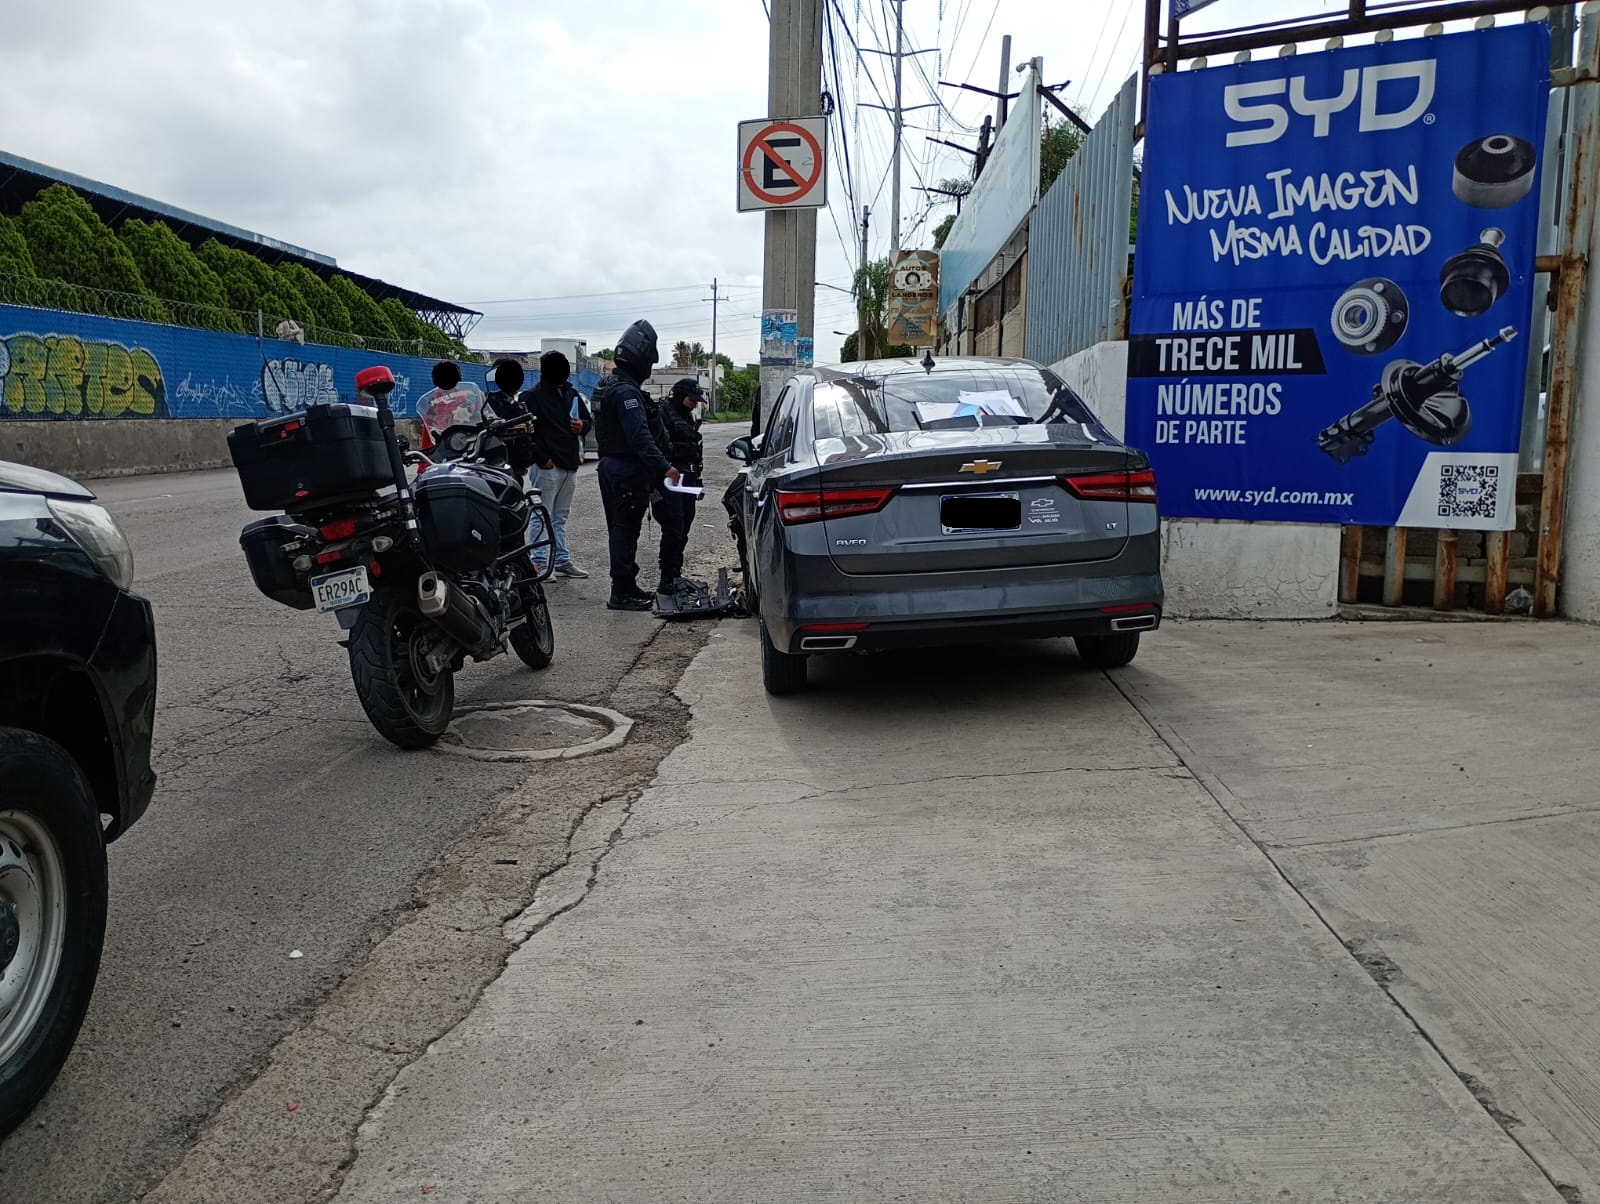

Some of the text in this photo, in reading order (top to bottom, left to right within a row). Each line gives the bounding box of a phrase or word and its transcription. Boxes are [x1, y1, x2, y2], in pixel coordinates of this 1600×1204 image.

[1223, 58, 1437, 148] SYD
[1164, 164, 1419, 225] NUEVA IMAGEN
[1172, 295, 1263, 331] MÁS DE
[1155, 334, 1303, 372] TRECE MIL
[1156, 378, 1282, 416] NÚMEROS
[1155, 420, 1247, 445] DE PARTE
[1194, 486, 1355, 507] www.syd.com.mx
[1457, 487, 1479, 495] SYD
[317, 577, 363, 602] ER29AC
